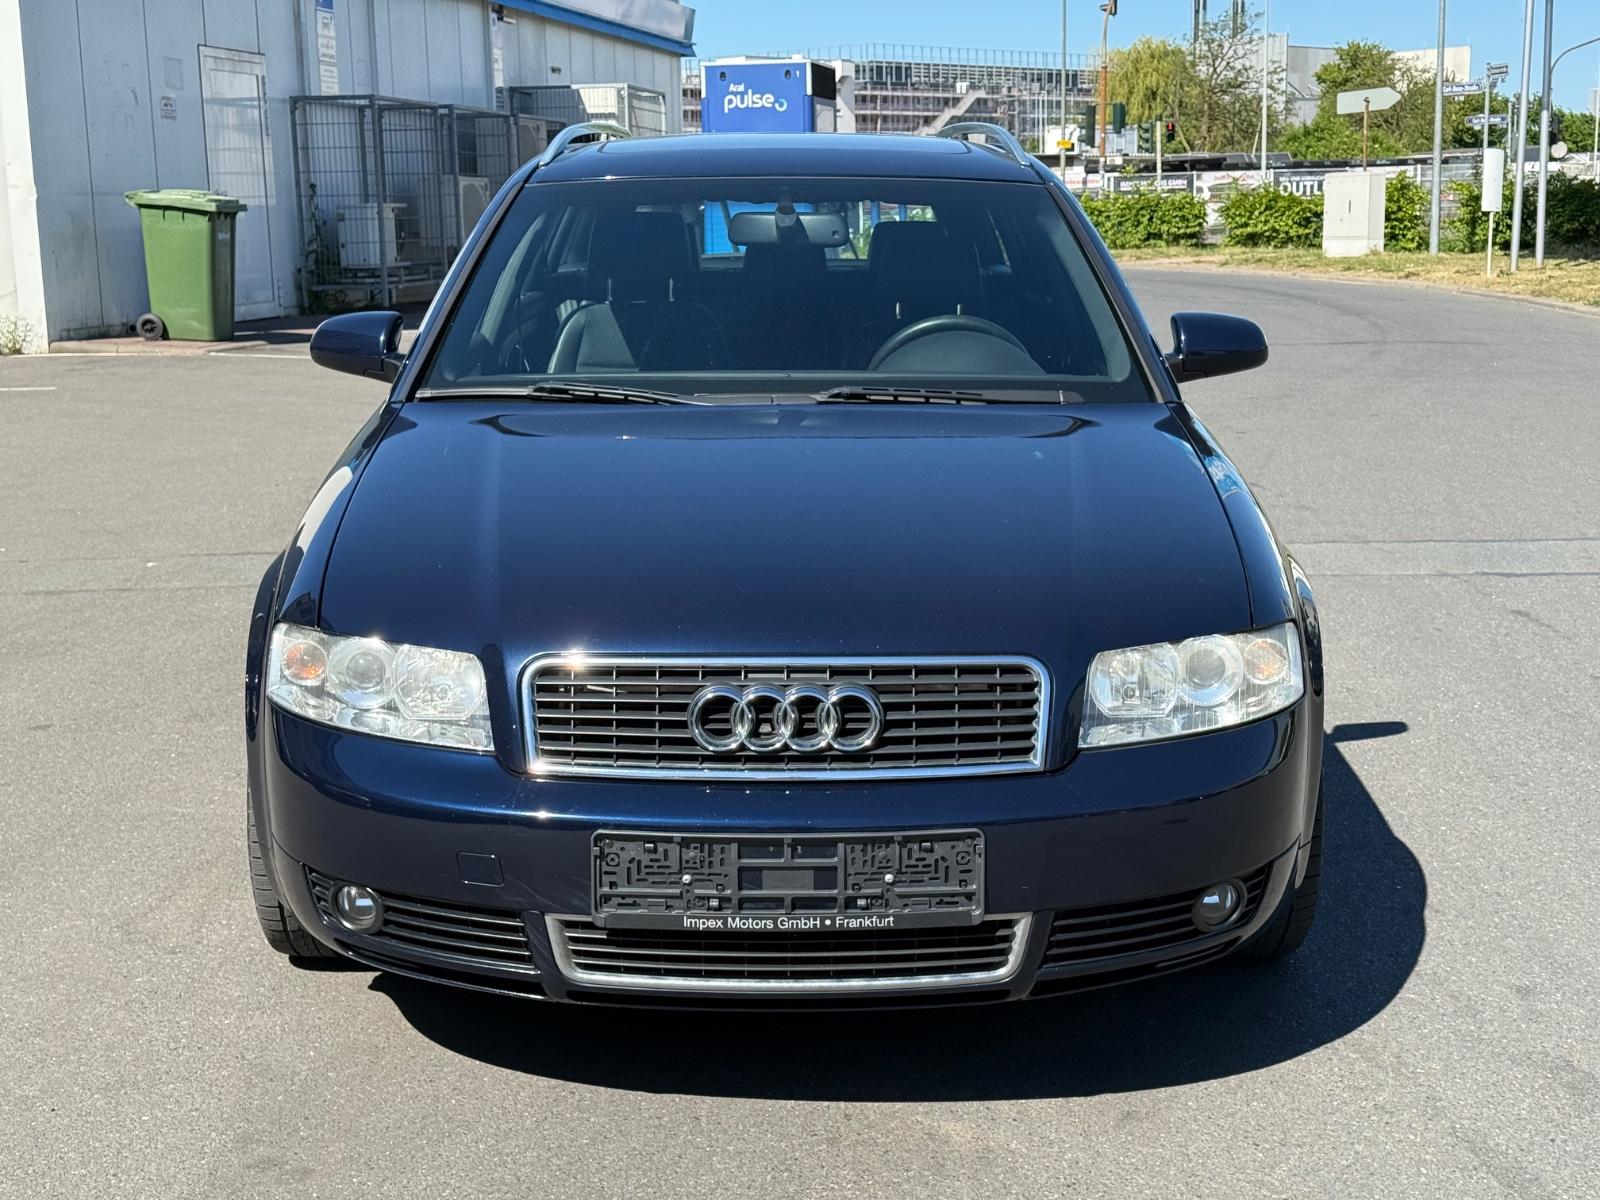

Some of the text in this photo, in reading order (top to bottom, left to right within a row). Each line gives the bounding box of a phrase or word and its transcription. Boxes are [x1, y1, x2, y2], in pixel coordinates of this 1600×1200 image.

[728, 83, 745, 92] Aral
[724, 89, 774, 113] pulse
[1279, 181, 1325, 197] OUTL
[683, 915, 895, 929] Impex Motors GmbH Frankfurt
